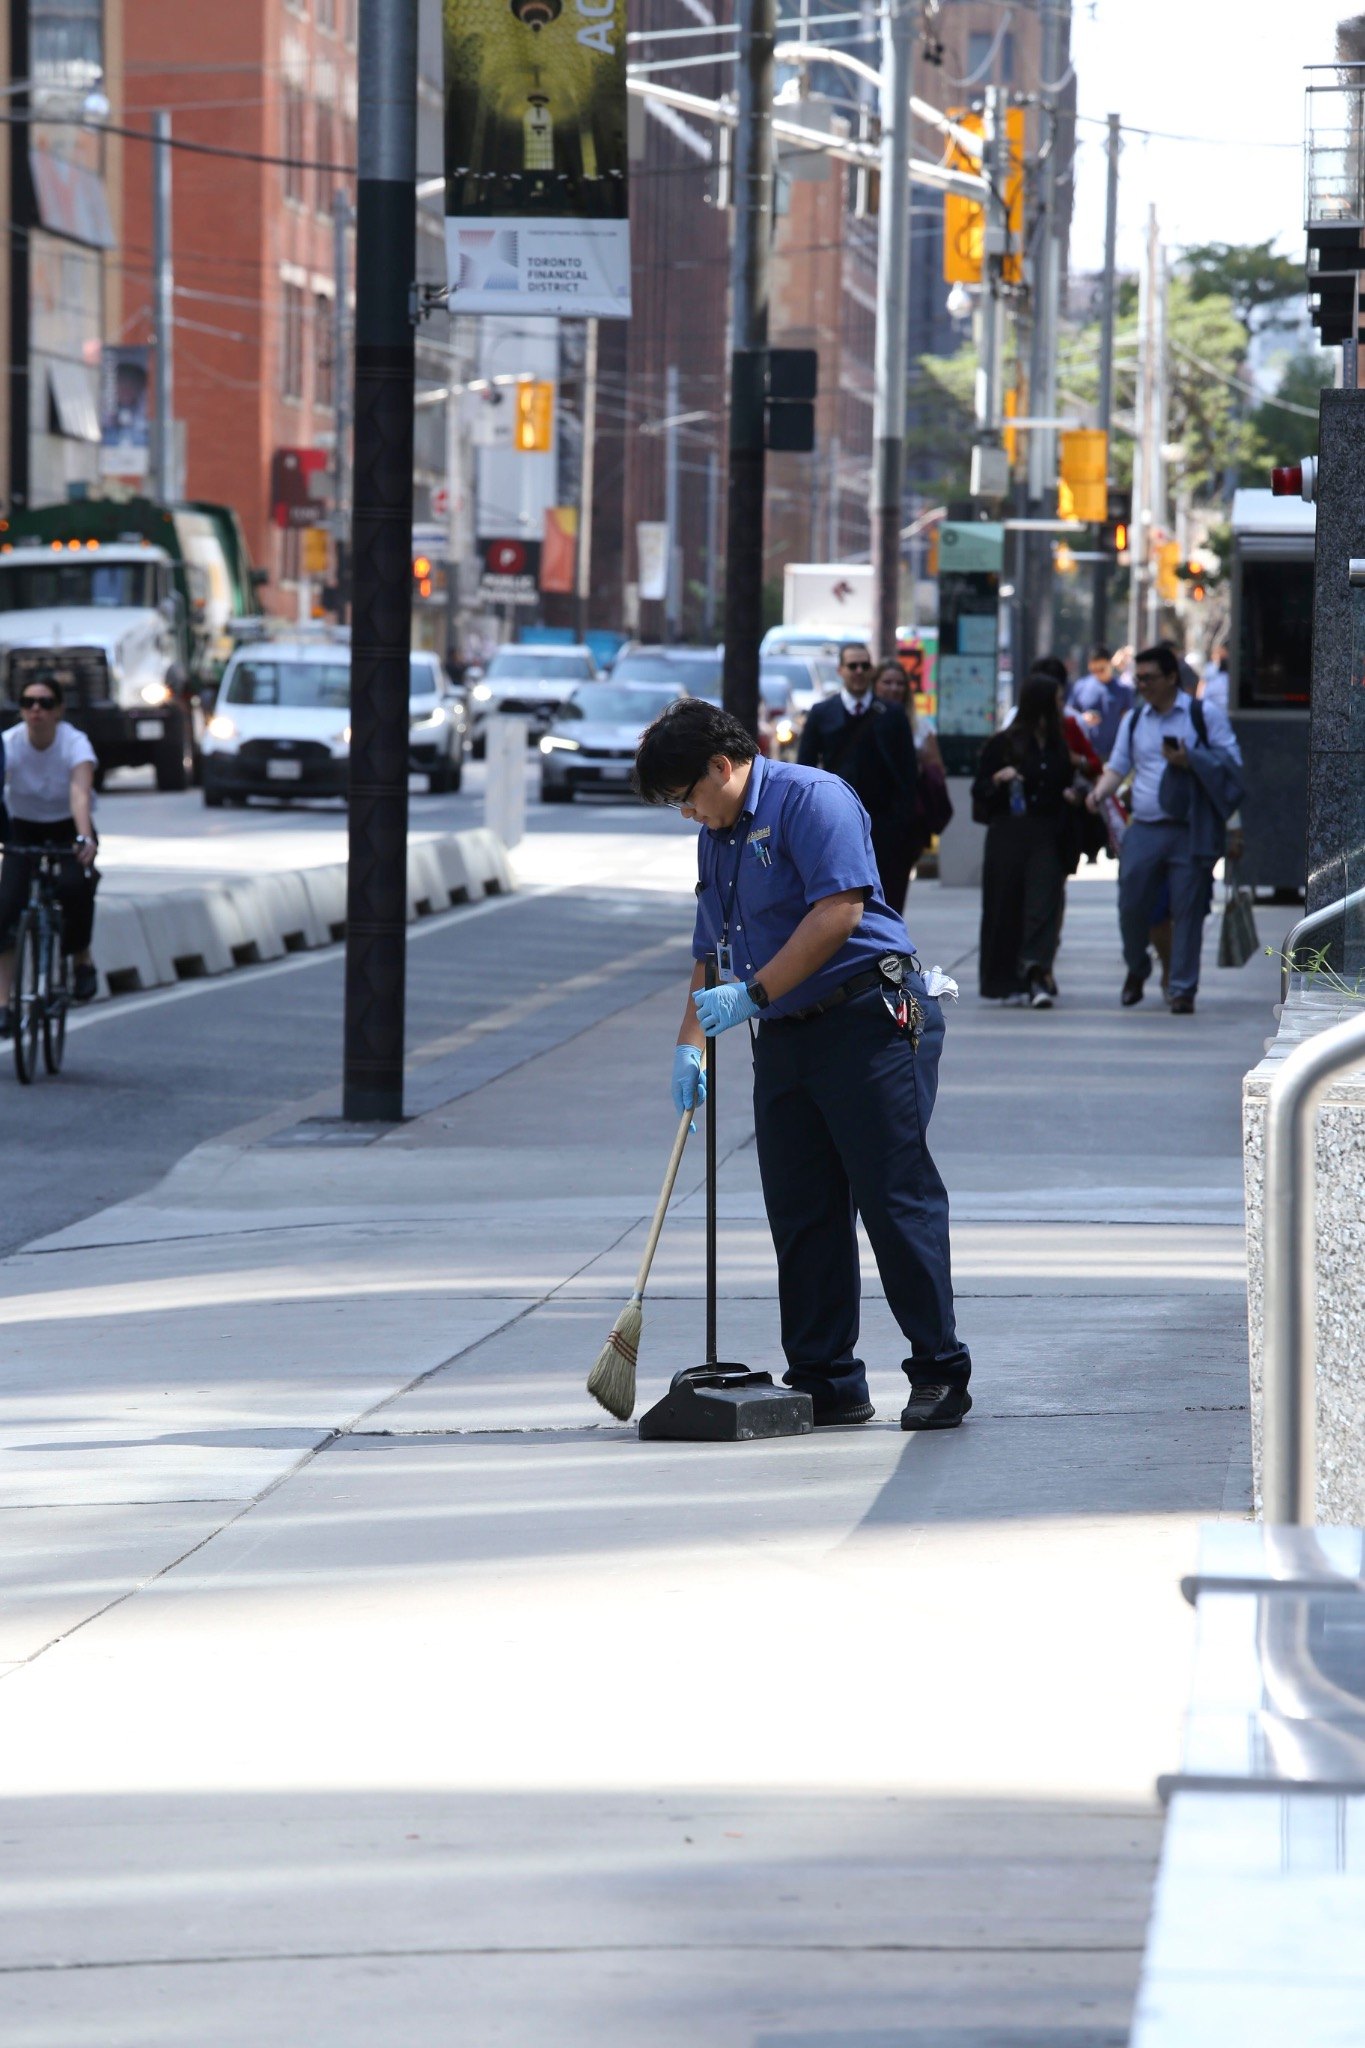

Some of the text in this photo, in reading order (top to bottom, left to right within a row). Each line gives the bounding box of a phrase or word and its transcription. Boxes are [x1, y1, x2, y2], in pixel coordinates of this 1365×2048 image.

[526, 257, 582, 268] TORONTO
[526, 269, 589, 281] FINANCIAL
[527, 282, 579, 292] DISTRICT
